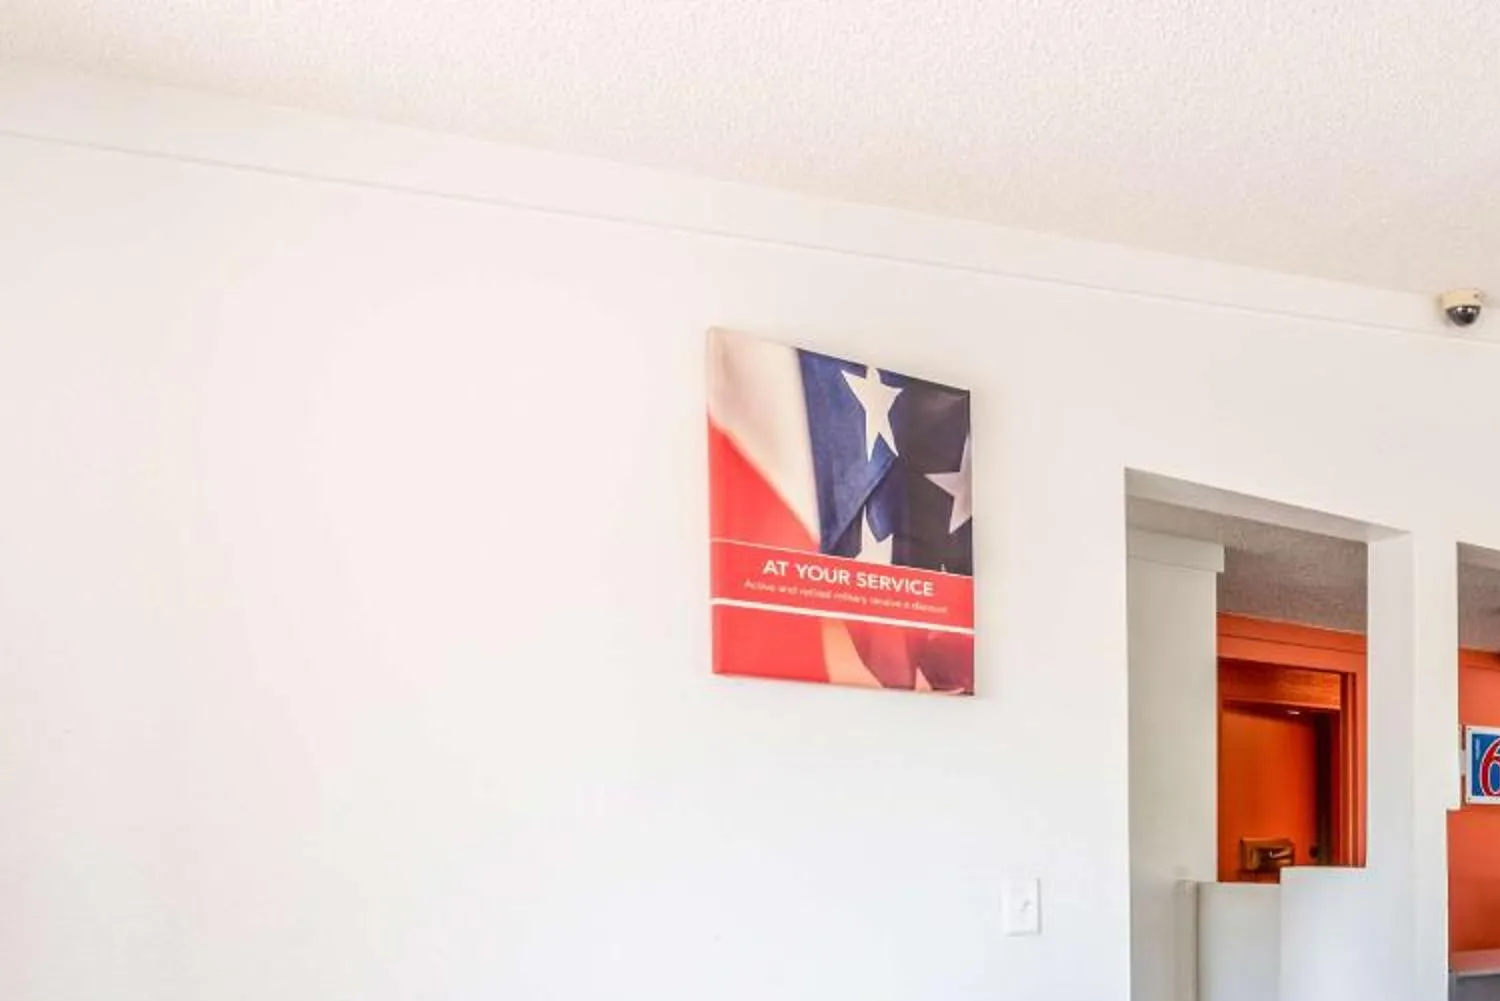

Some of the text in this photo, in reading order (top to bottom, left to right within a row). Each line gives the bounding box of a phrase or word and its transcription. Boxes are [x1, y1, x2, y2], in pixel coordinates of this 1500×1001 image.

[762, 559, 935, 597] AT YOUR SERVICE
